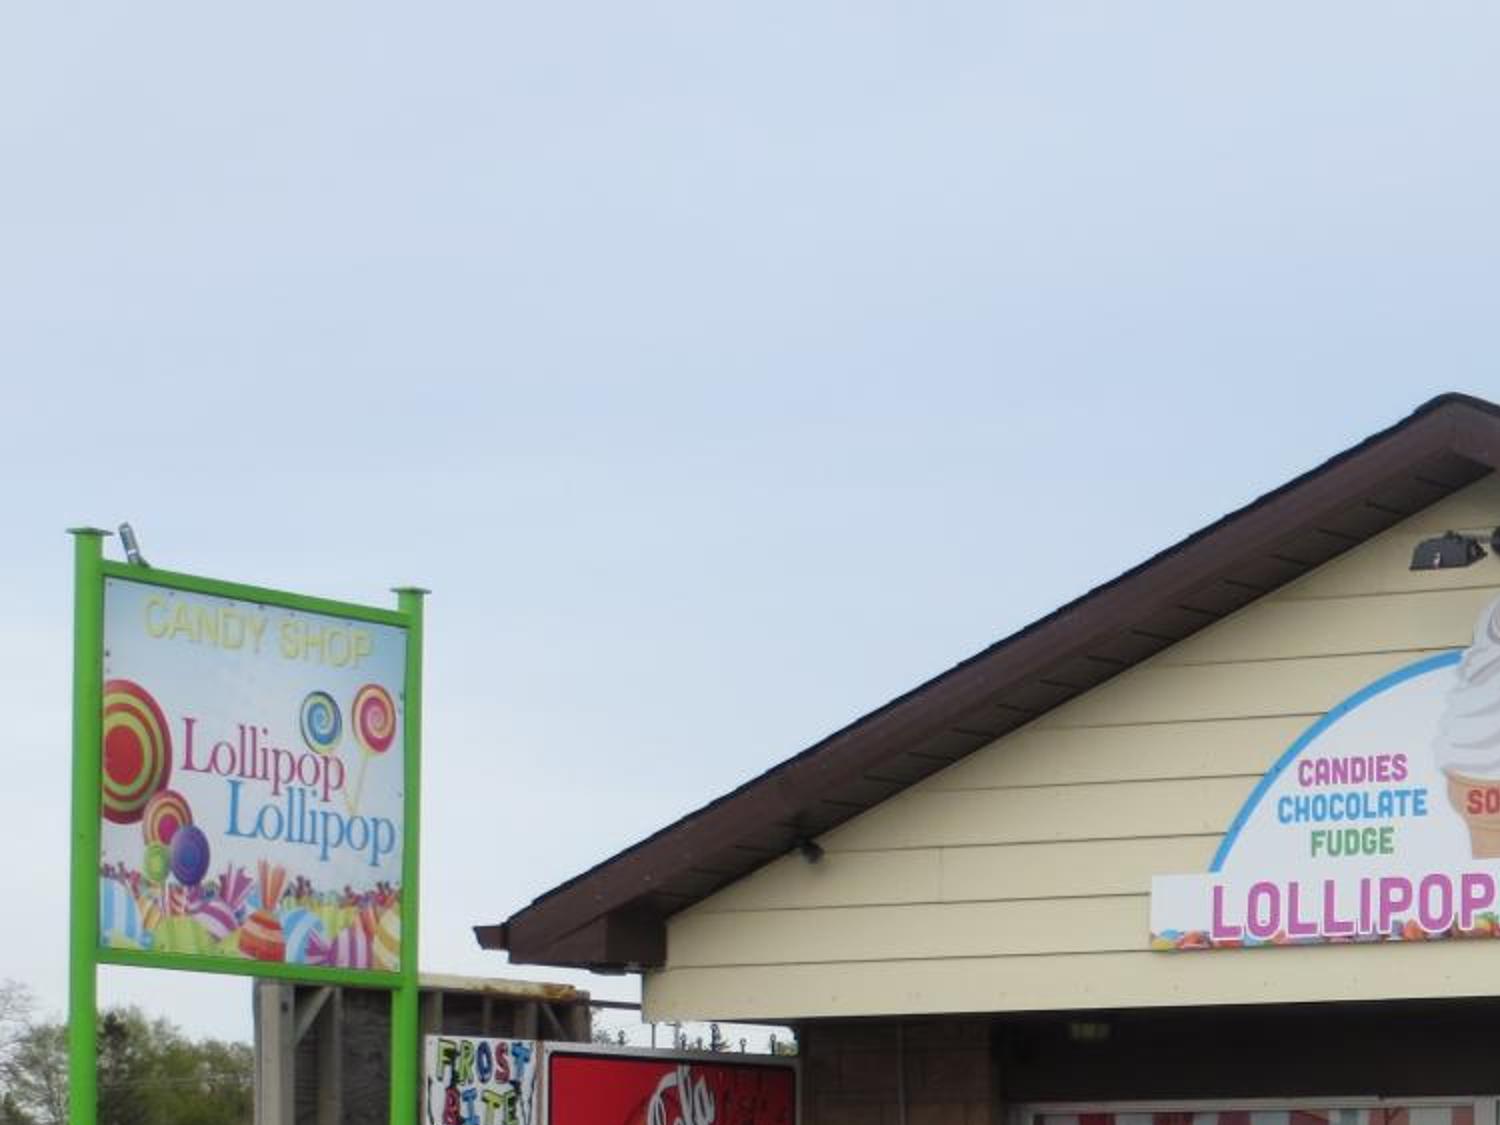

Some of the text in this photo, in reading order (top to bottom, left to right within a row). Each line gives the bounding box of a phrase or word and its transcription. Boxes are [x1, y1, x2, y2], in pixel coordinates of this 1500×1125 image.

[144, 594, 373, 668] CANDY SHOP
[181, 718, 345, 802] Lollipop
[1298, 753, 1408, 787] CANDIES
[224, 780, 396, 866] Lollipop
[1278, 788, 1428, 824] CHOCOLATE
[1311, 827, 1395, 858] FUDGE
[436, 1037, 531, 1085] FROST
